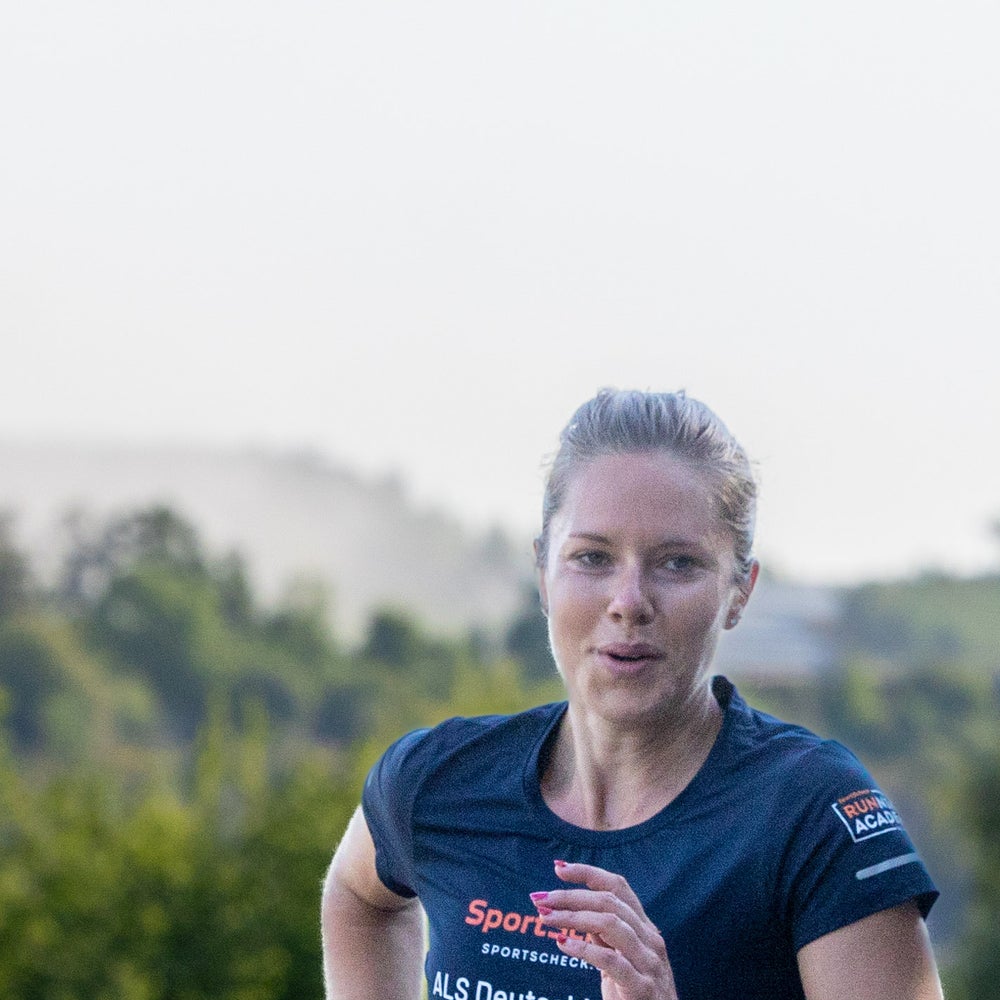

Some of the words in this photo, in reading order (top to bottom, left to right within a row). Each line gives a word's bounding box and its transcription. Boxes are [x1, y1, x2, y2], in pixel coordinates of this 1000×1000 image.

[853, 809, 900, 834] ACAD
[464, 898, 593, 943] Sport
[481, 943, 600, 971] SPORTSCHECK.
